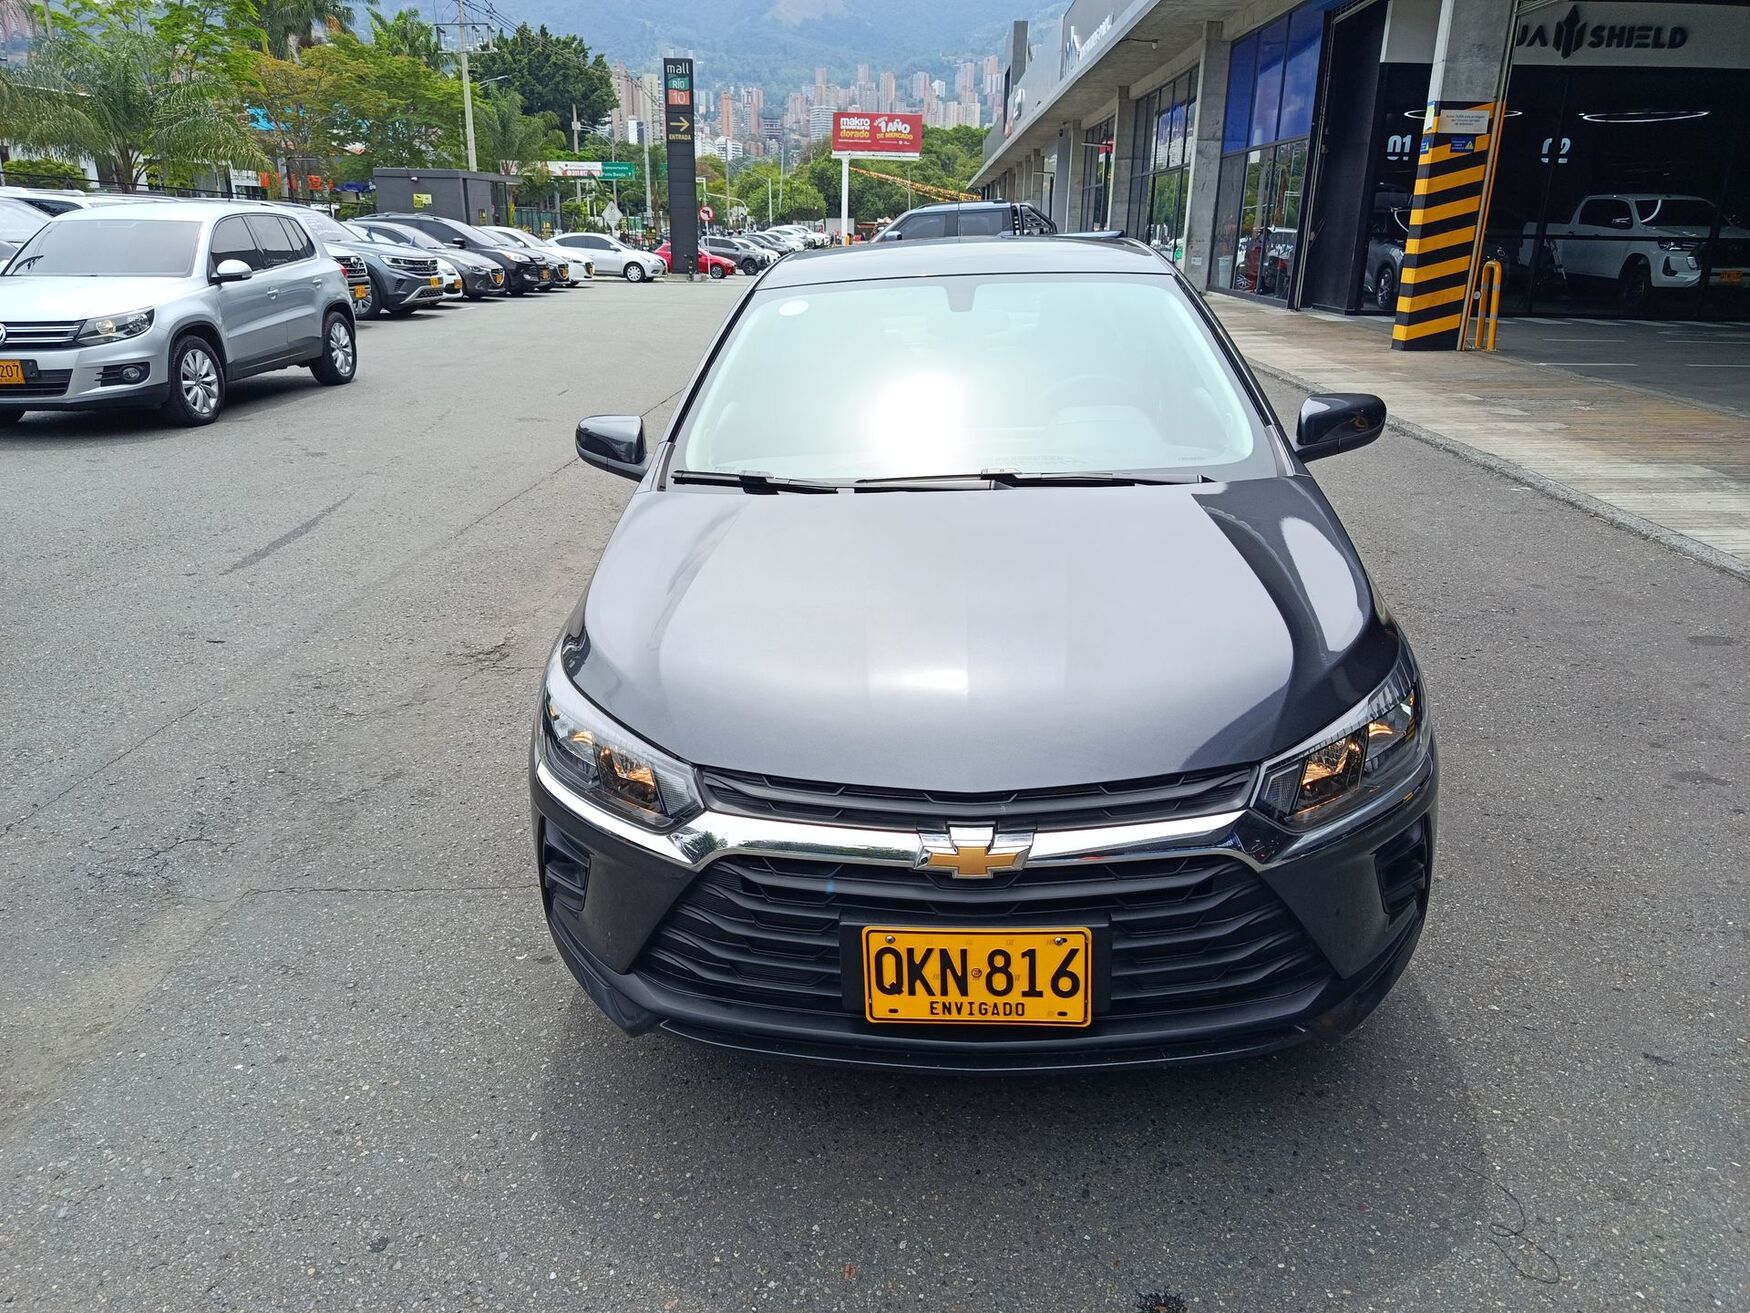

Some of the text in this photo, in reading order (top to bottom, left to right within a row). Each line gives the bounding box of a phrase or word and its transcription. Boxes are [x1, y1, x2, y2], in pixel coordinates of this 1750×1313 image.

[1588, 25, 1688, 49] SHIELD
[667, 62, 689, 74] mall
[673, 92, 686, 104] 10
[840, 117, 870, 126] makro
[887, 119, 910, 133] AÑO
[840, 129, 870, 138] dorado
[1386, 134, 1412, 161] 01
[874, 946, 1081, 998] QKN 816
[930, 1001, 1025, 1017] ENVIGADO
